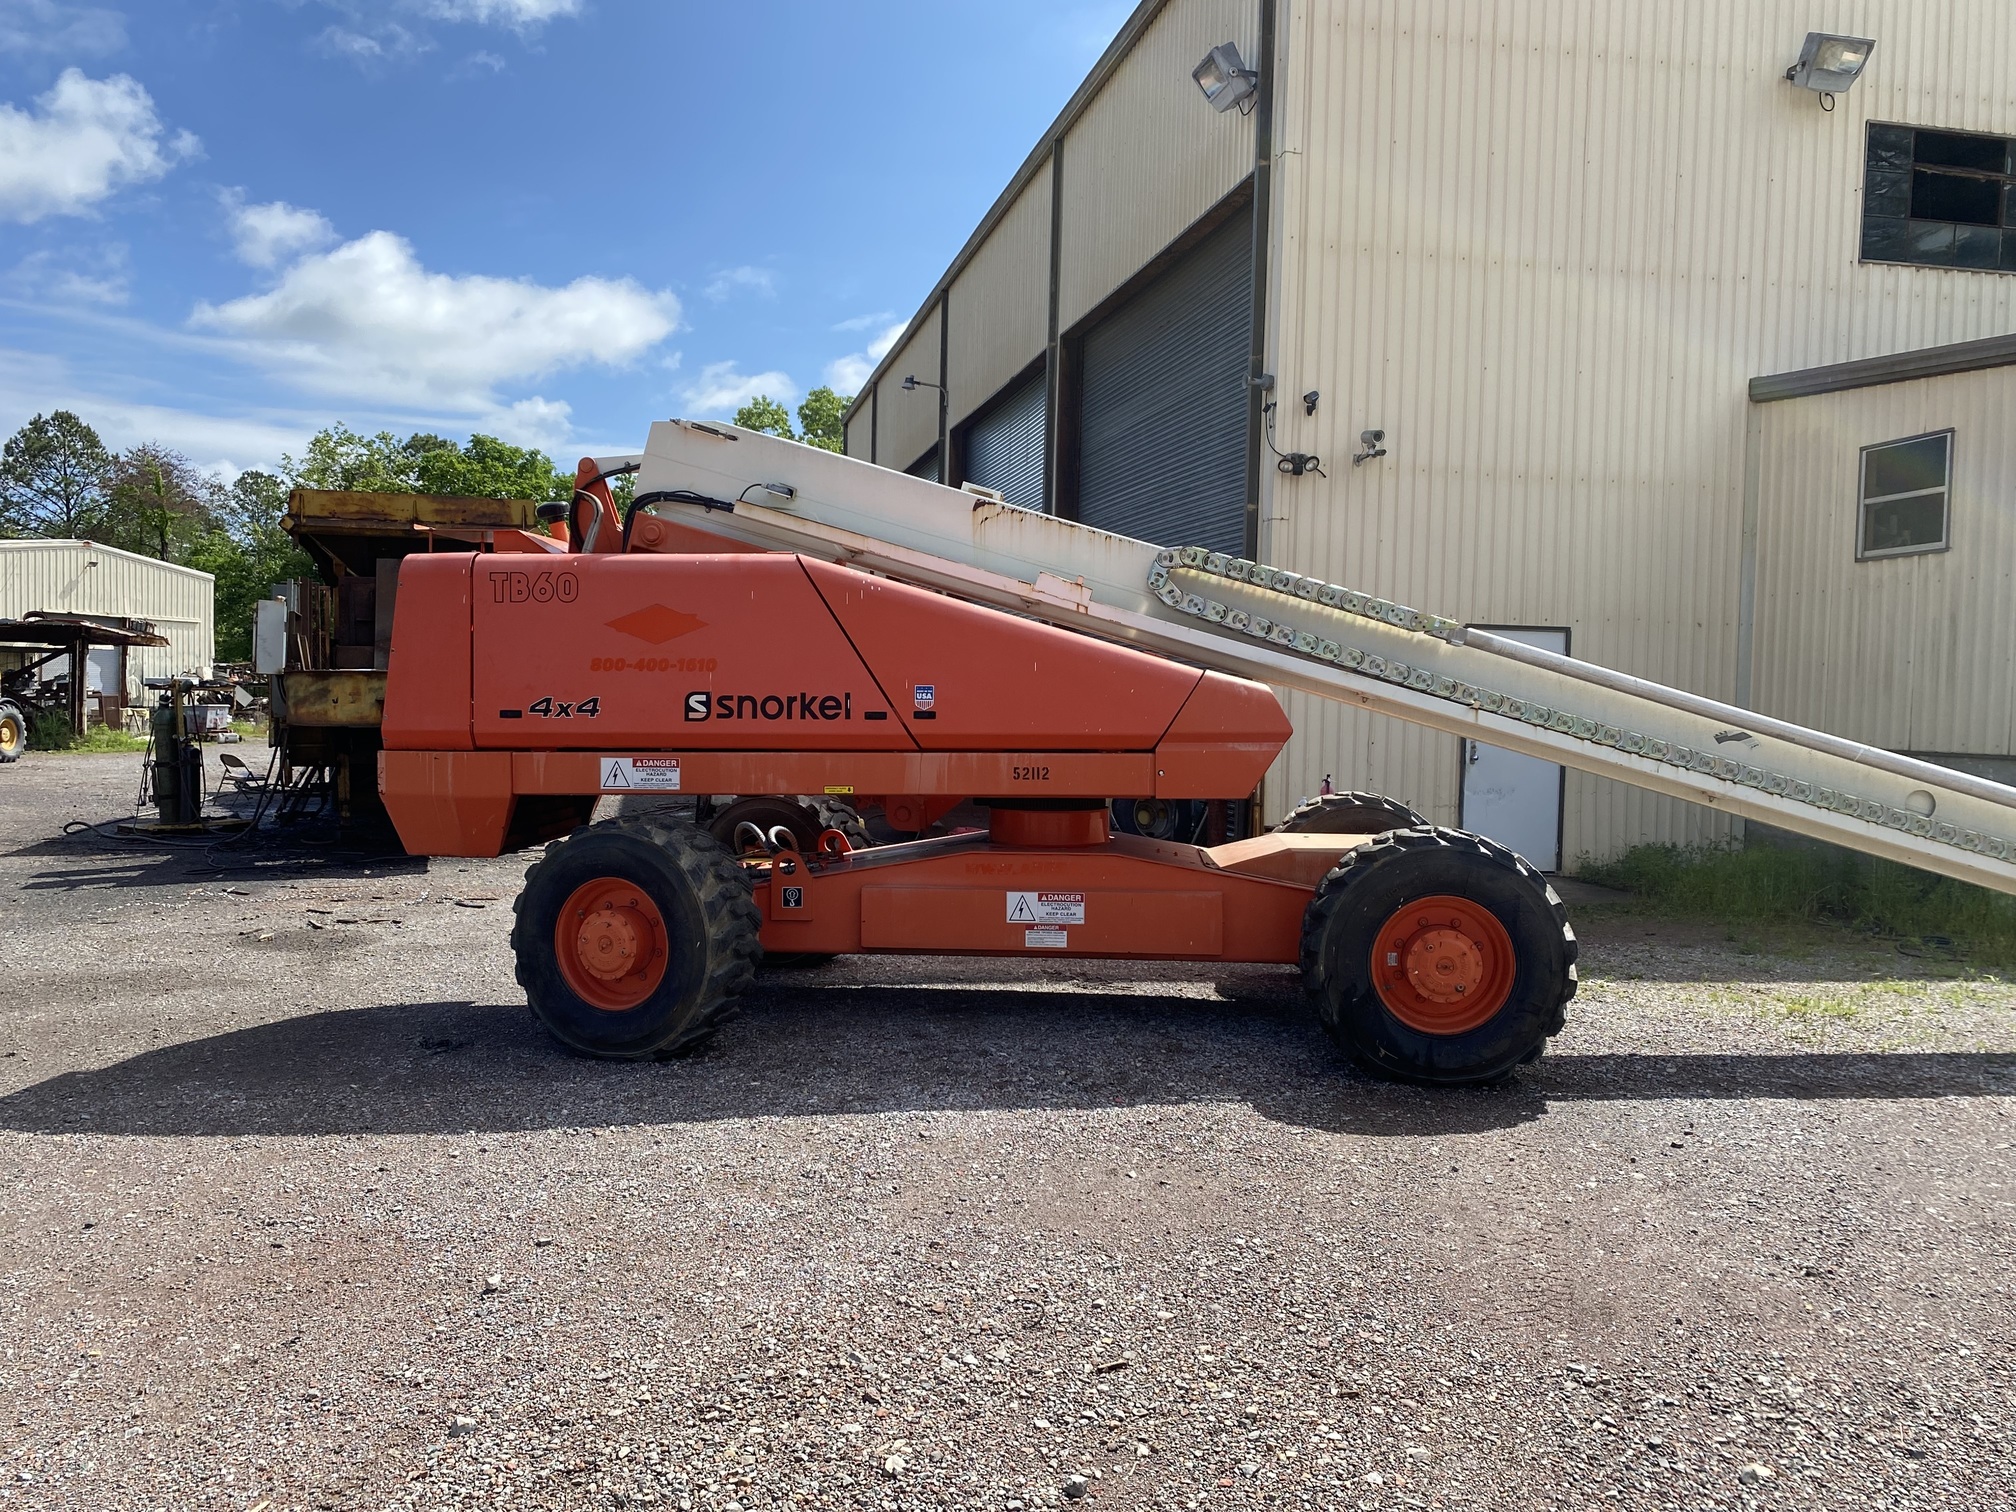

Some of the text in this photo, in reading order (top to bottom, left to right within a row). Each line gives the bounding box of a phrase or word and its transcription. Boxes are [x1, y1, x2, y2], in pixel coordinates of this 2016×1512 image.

[489, 572, 579, 603] TB60
[528, 696, 601, 719] 4x4
[716, 692, 851, 720] snorkel
[1013, 767, 1050, 780] 52112
[1048, 894, 1082, 902] DANGER
